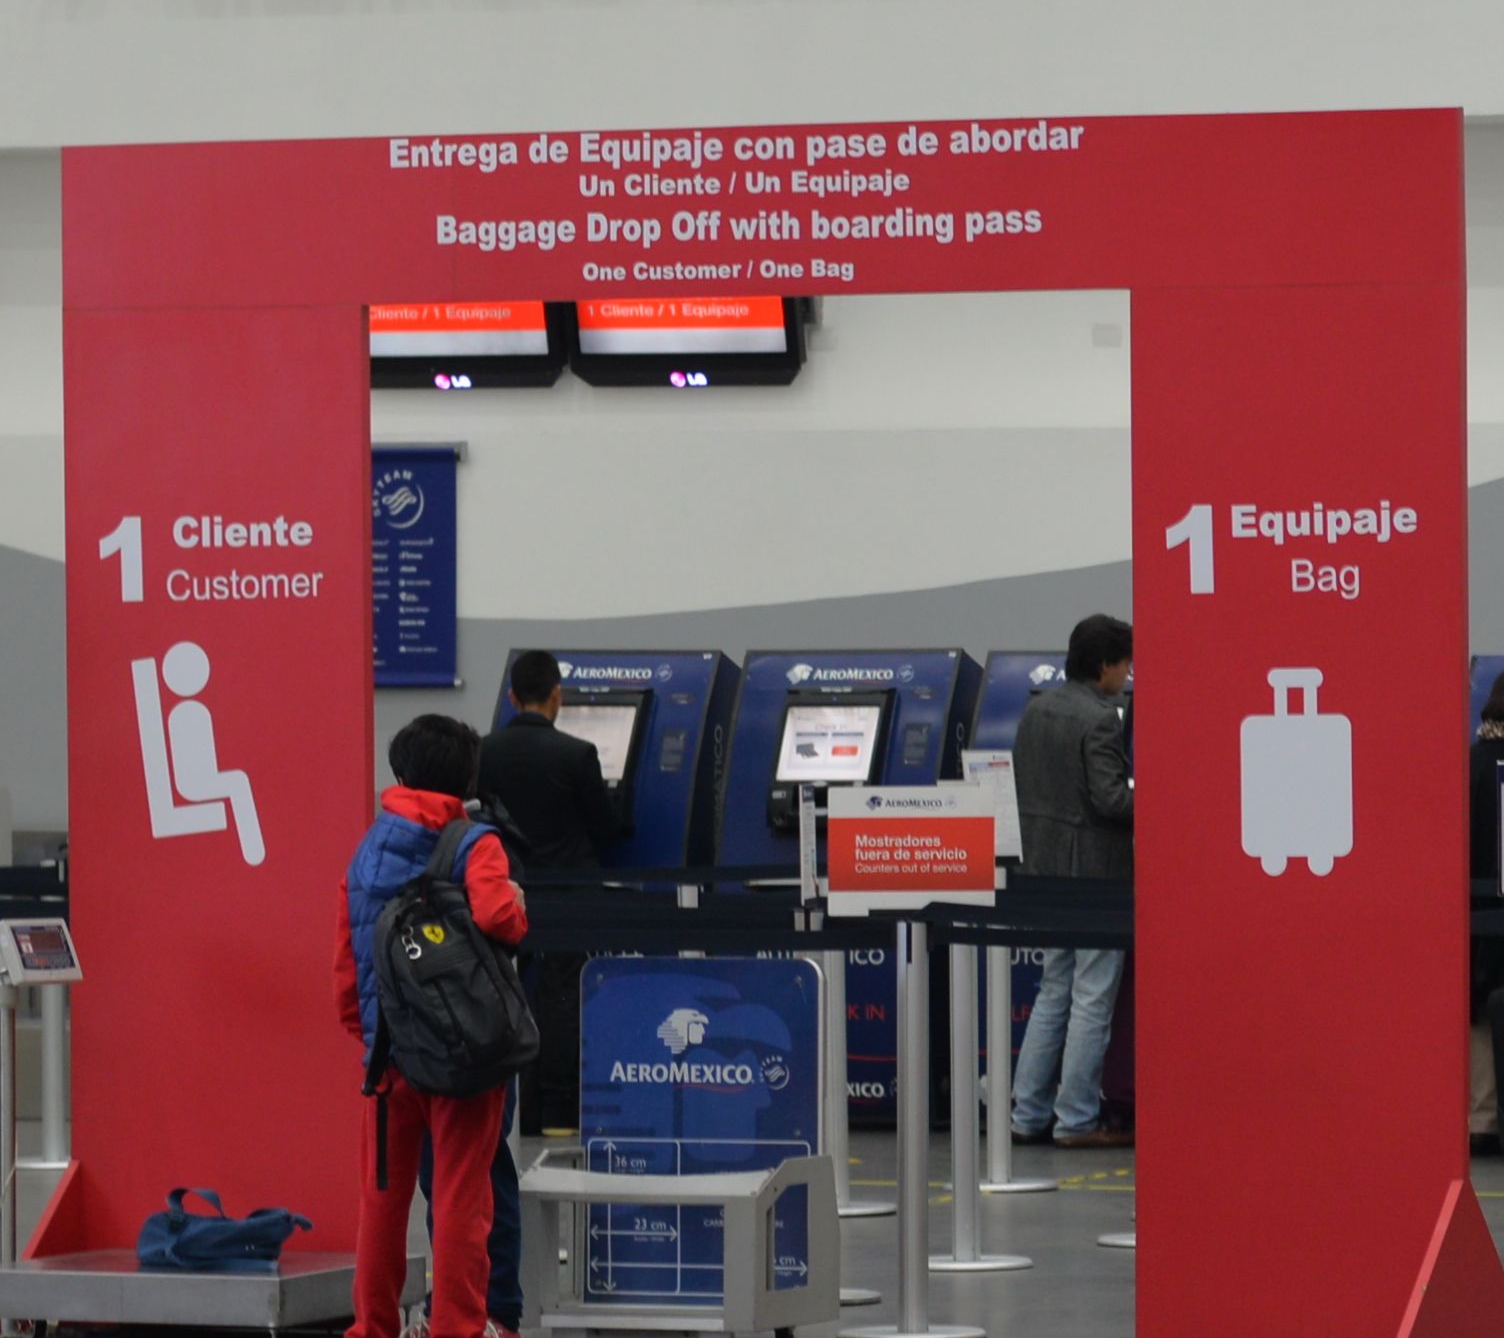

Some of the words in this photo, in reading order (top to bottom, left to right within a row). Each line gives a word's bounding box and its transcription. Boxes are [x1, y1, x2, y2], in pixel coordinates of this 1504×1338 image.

[390, 138, 518, 172] Entrega
[529, 134, 569, 164] de
[580, 131, 723, 169] Equipaje
[734, 135, 794, 160] con
[807, 134, 886, 165] pase
[898, 126, 938, 156] de
[950, 121, 1084, 153] abordar
[579, 175, 615, 196] Un
[624, 173, 721, 196] Cliente
[729, 172, 737, 194] /
[746, 171, 781, 193] Un
[791, 169, 909, 197] Equipaje
[436, 215, 576, 251] Baggage
[587, 212, 661, 248] Drop
[672, 211, 721, 241] Off
[730, 210, 800, 240] with
[811, 208, 954, 243] boarding
[966, 210, 1042, 242] pass
[582, 263, 626, 281] One
[633, 262, 741, 281] Customer
[747, 260, 753, 278] /
[760, 260, 803, 278] One
[811, 259, 855, 281] Bag
[422, 306, 430, 320] /
[433, 306, 440, 319] 1
[445, 305, 511, 321] Equipaje
[600, 304, 654, 318] Cliente
[658, 304, 665, 317] /
[670, 304, 676, 316] 1
[681, 303, 748, 319] Equipaje
[1165, 504, 1214, 594] 1
[1231, 500, 1418, 545] Equipaje
[99, 516, 144, 602] 1
[172, 515, 313, 548] Cliente
[166, 569, 323, 601] Customer
[1291, 558, 1360, 599] Bag
[573, 667, 652, 679] AEROMEXICO
[813, 666, 894, 681] AEROMEXICO
[885, 798, 942, 808] AEROMEXICO
[855, 834, 941, 847] Mostradores
[855, 848, 890, 860] fuera
[894, 848, 910, 860] de
[914, 848, 967, 860] servicio
[855, 864, 900, 874] Counters
[901, 864, 918, 874] out
[920, 863, 931, 874] of
[932, 863, 967, 874] service
[609, 1060, 754, 1085] AEROMEXICO
[615, 1156, 628, 1167] 36
[630, 1158, 646, 1167] cm
[634, 1218, 648, 1230] 23
[650, 1220, 667, 1230] cm
